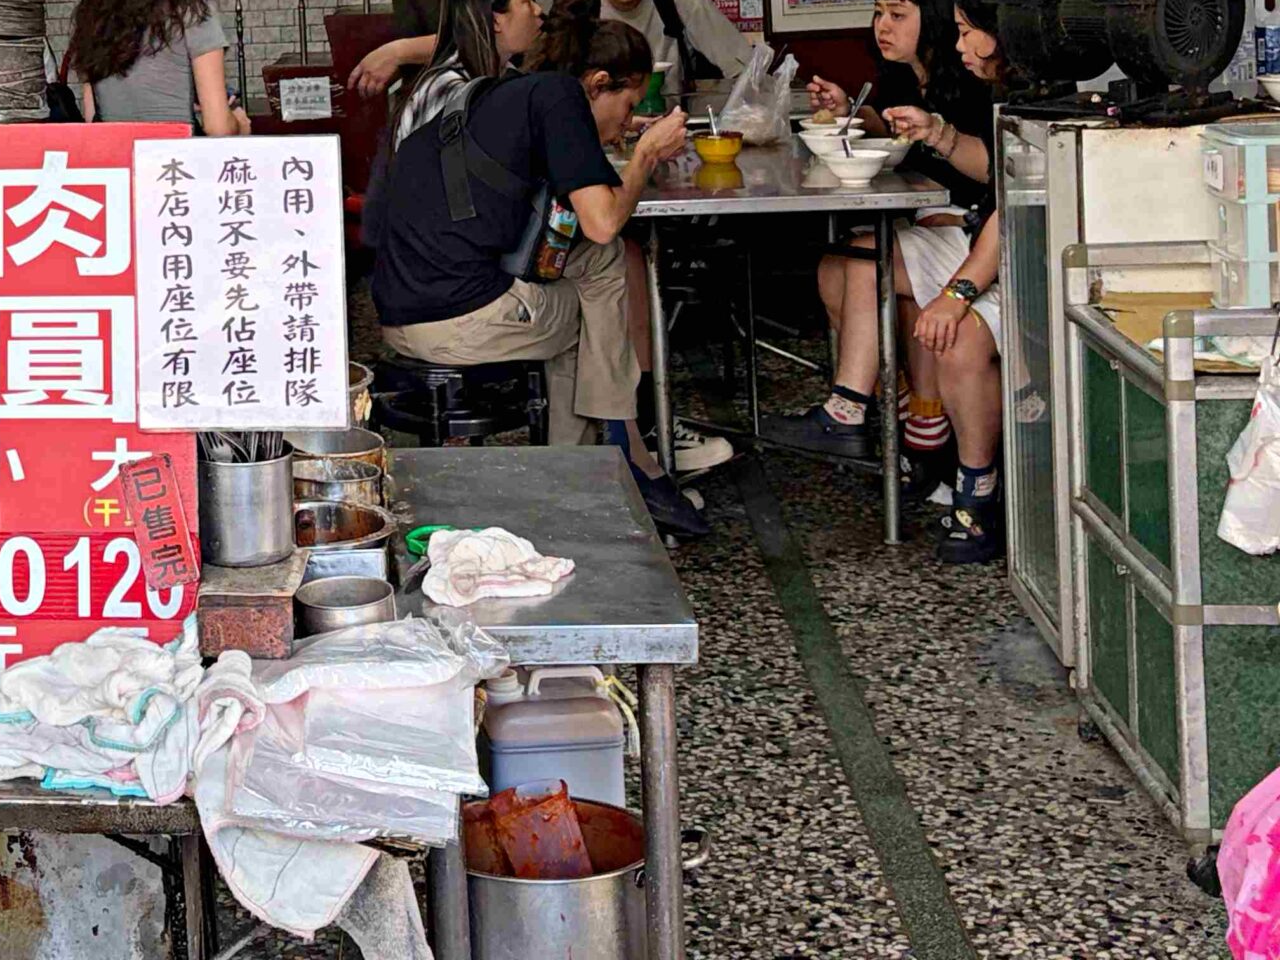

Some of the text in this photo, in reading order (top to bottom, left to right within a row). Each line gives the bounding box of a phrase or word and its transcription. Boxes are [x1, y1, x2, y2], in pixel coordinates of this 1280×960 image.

[156, 157, 201, 409] 本店內用座位有限
[216, 156, 261, 407] 麻煩不要先佔座位
[281, 155, 323, 408] 內用、外帶請排隊
[131, 465, 189, 581] 已售完
